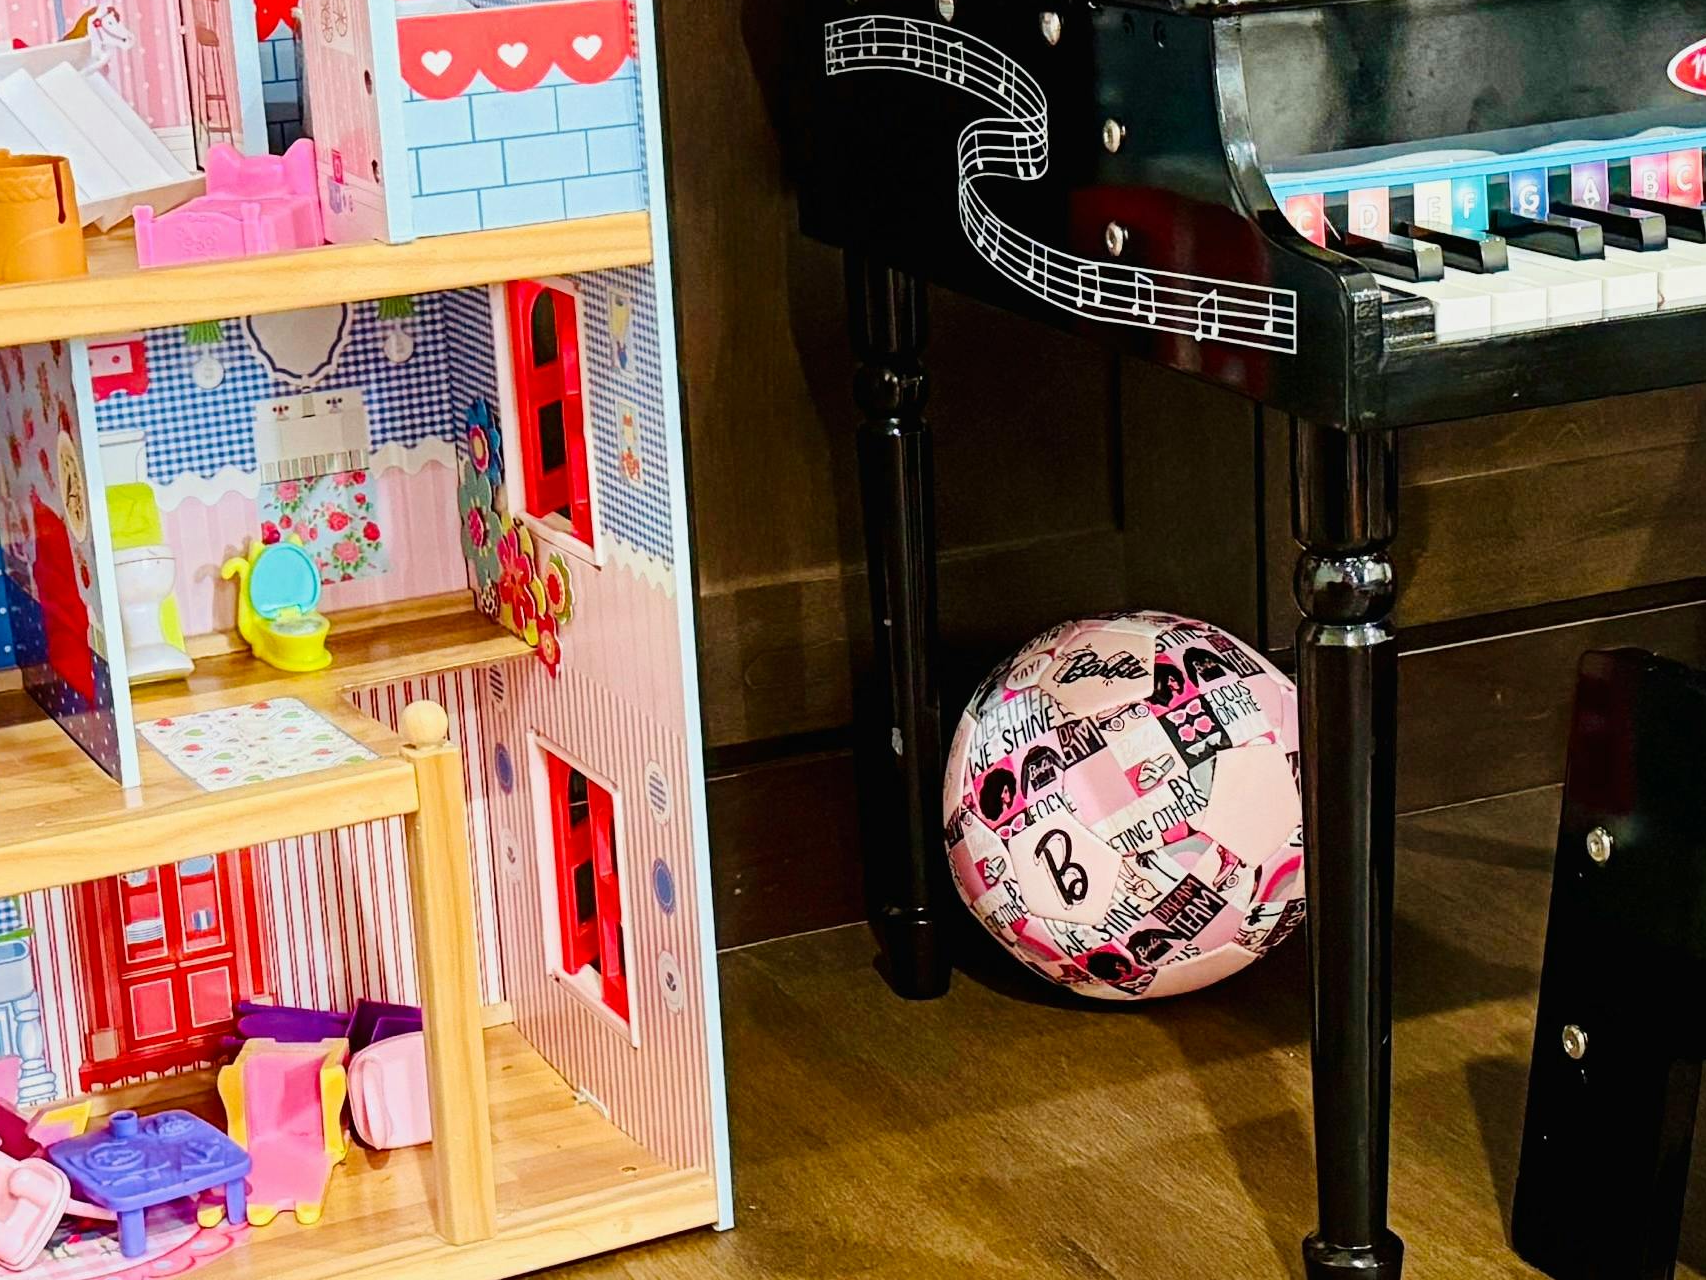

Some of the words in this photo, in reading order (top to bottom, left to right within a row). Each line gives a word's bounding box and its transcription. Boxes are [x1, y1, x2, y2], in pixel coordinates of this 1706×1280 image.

[1294, 208, 1314, 238] C
[1359, 203, 1380, 235] D
[1461, 190, 1477, 219] F
[1519, 183, 1541, 212] G
[1583, 176, 1601, 205] A
[1643, 169, 1659, 195] B
[1675, 164, 1694, 192] C
[1060, 649, 1150, 684] Barbie
[1215, 700, 1240, 726] ON
[1235, 694, 1261, 717] THE
[969, 742, 995, 776] WE
[1001, 704, 1057, 755] SHINE
[1152, 790, 1209, 834] OTHERS
[1033, 829, 1090, 910] B
[1154, 878, 1202, 921] DREAM
[1168, 890, 1224, 940] TEAM
[1053, 930, 1093, 960] WE
